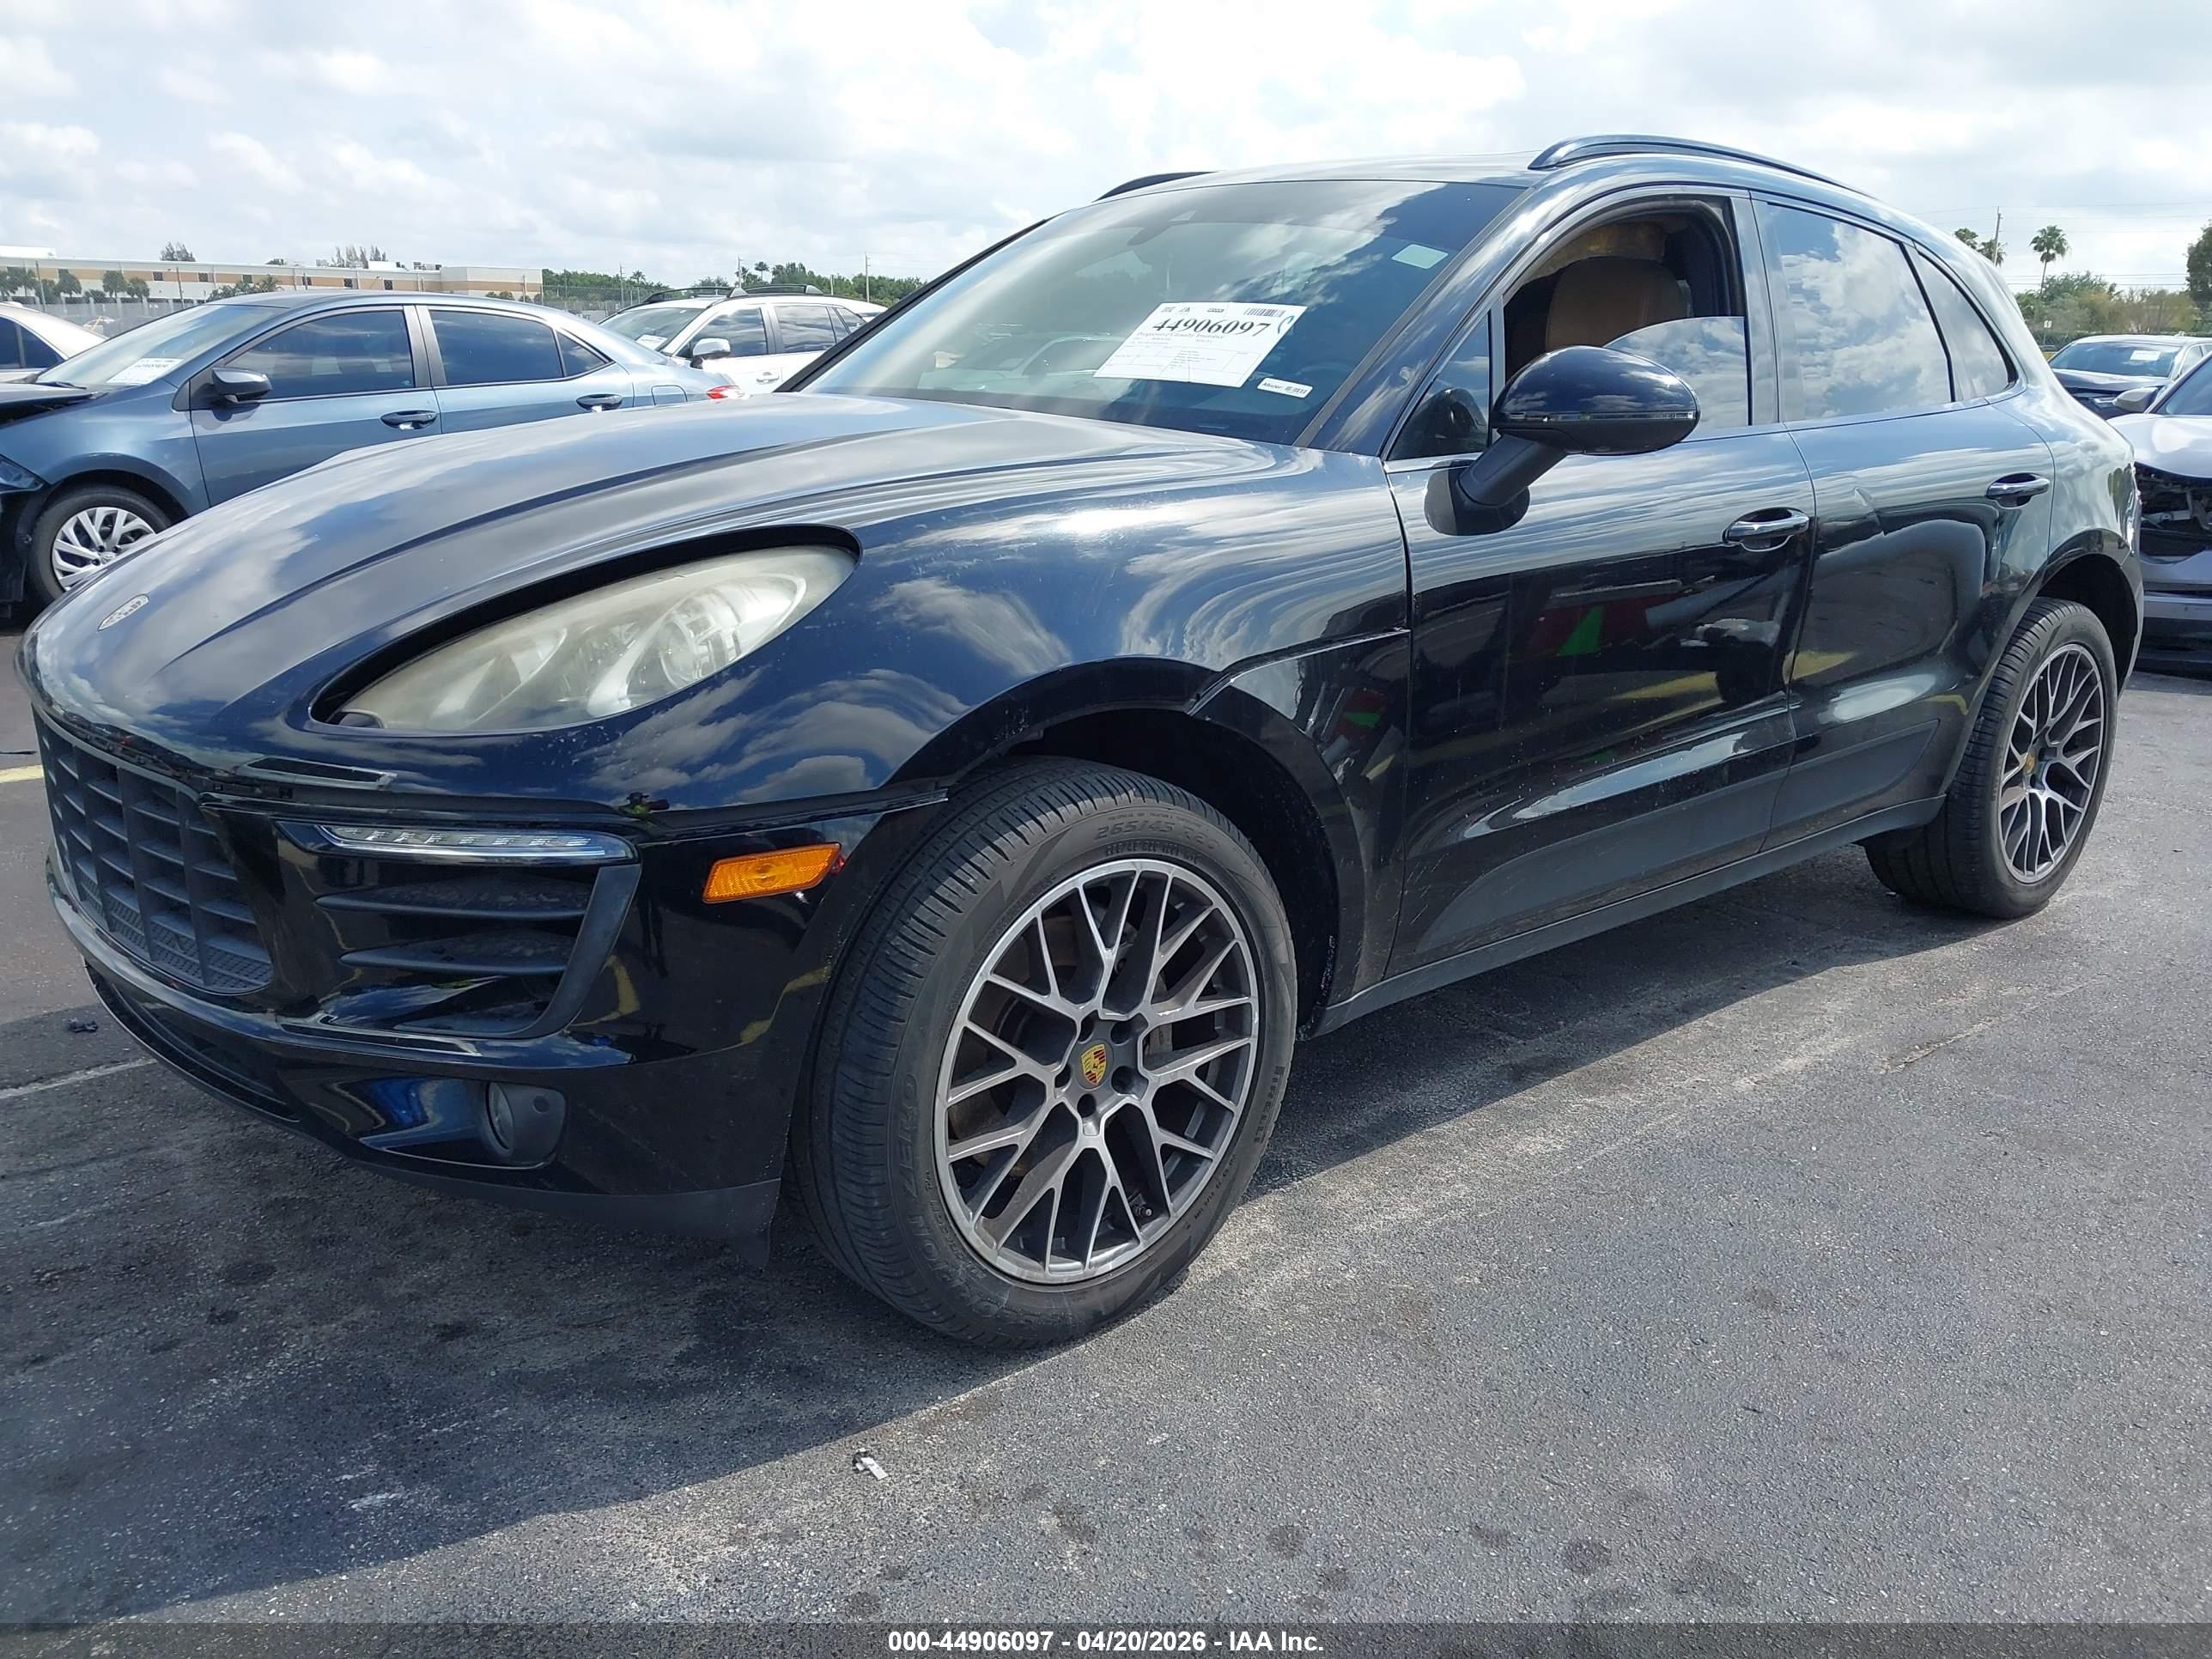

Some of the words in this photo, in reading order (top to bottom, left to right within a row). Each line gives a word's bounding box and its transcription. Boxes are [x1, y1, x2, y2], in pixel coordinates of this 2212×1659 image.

[1152, 319, 1271, 337] 44906097
[1095, 819, 1175, 841] 265/45
[1255, 1066, 1285, 1144] PIRELLI
